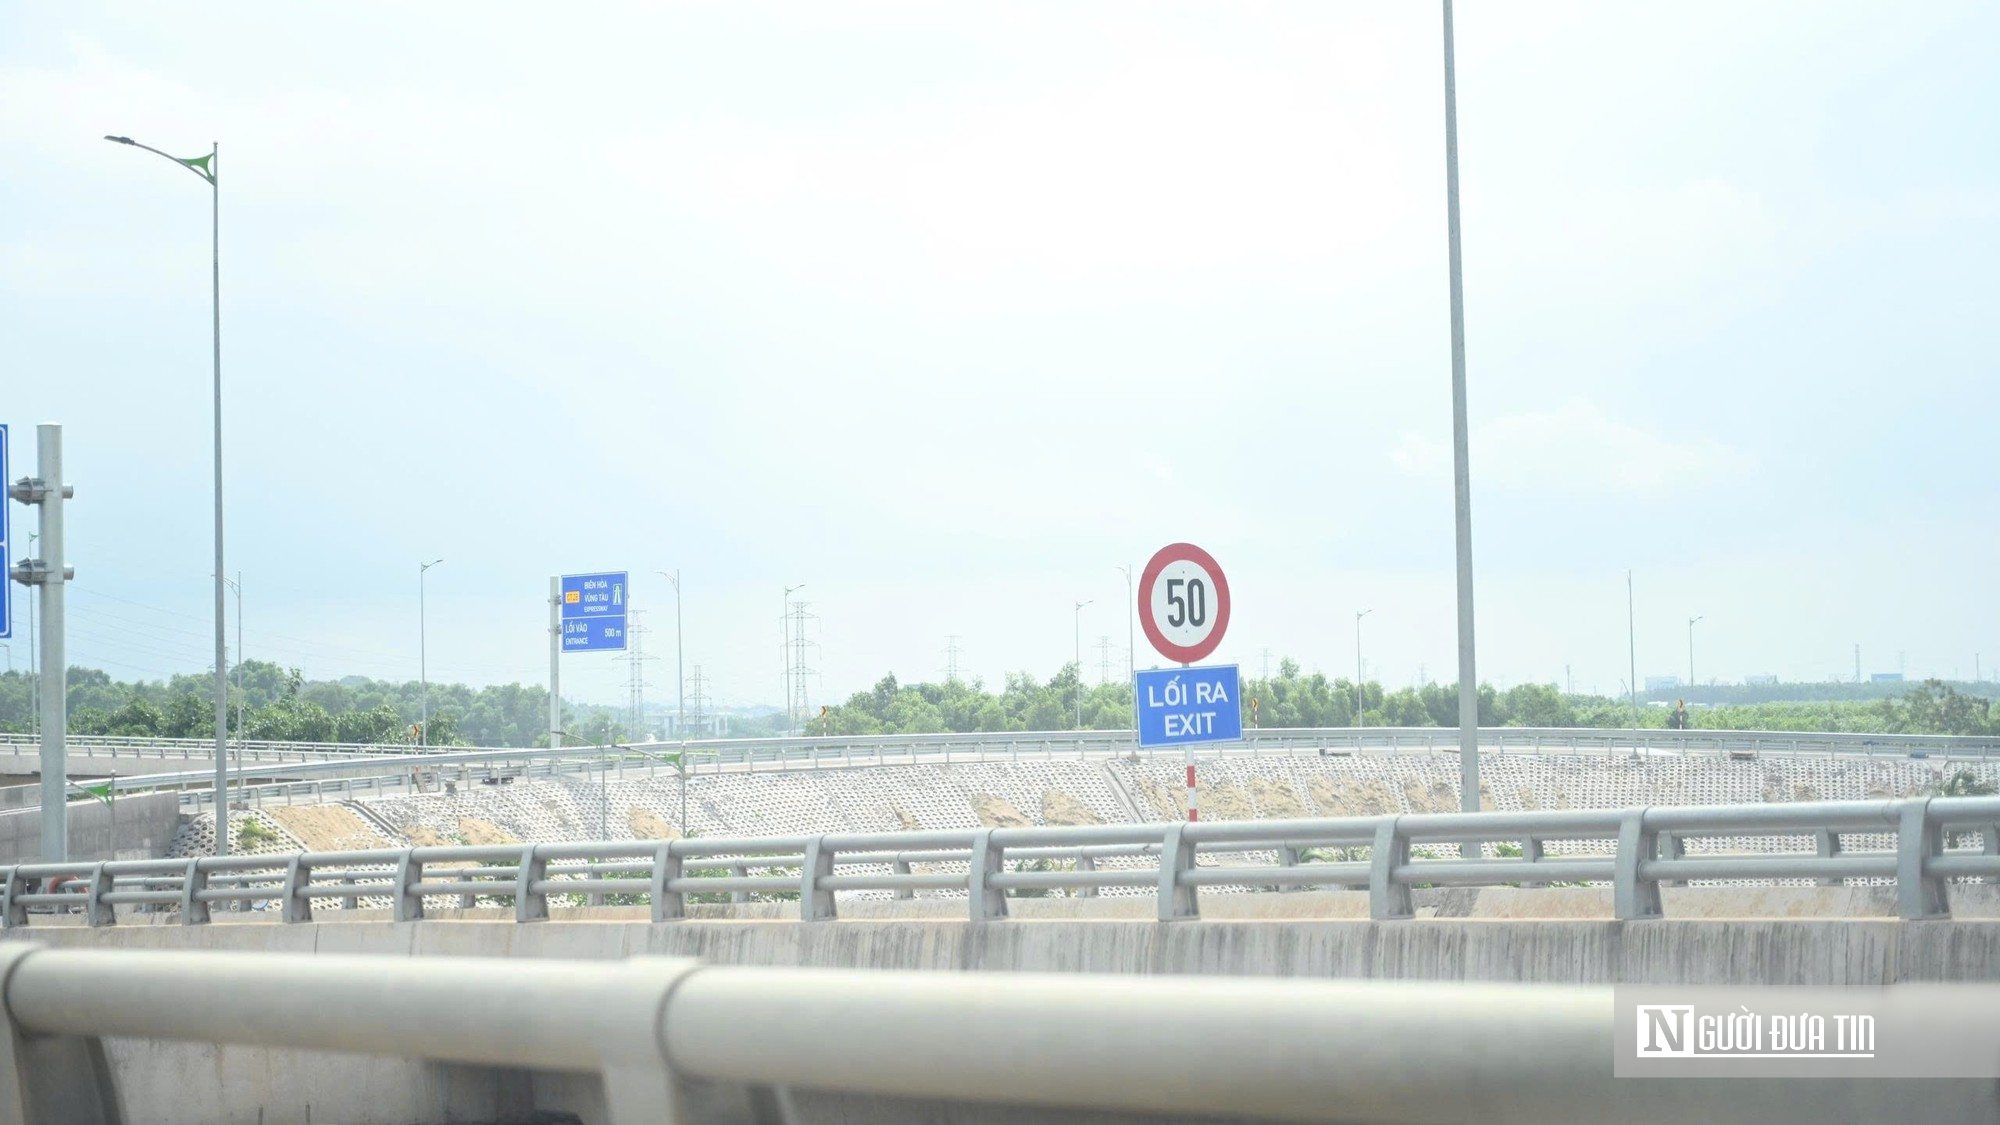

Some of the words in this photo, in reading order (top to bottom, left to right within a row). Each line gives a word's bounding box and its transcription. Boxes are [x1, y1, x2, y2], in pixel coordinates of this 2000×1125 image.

[584, 580, 596, 590] BIÊN
[597, 578, 608, 589] HÒA
[599, 591, 609, 601] TÀU
[1167, 578, 1206, 627] 50
[584, 605, 609, 613] EXPRESSWAY
[565, 620, 575, 633] LỐI
[576, 622, 588, 633] VÀO
[605, 628, 615, 638] 500
[565, 637, 588, 646] ENTRANCE
[1148, 675, 1188, 708] LỐI
[1196, 681, 1229, 705] RA
[1164, 712, 1217, 737] EXIT
